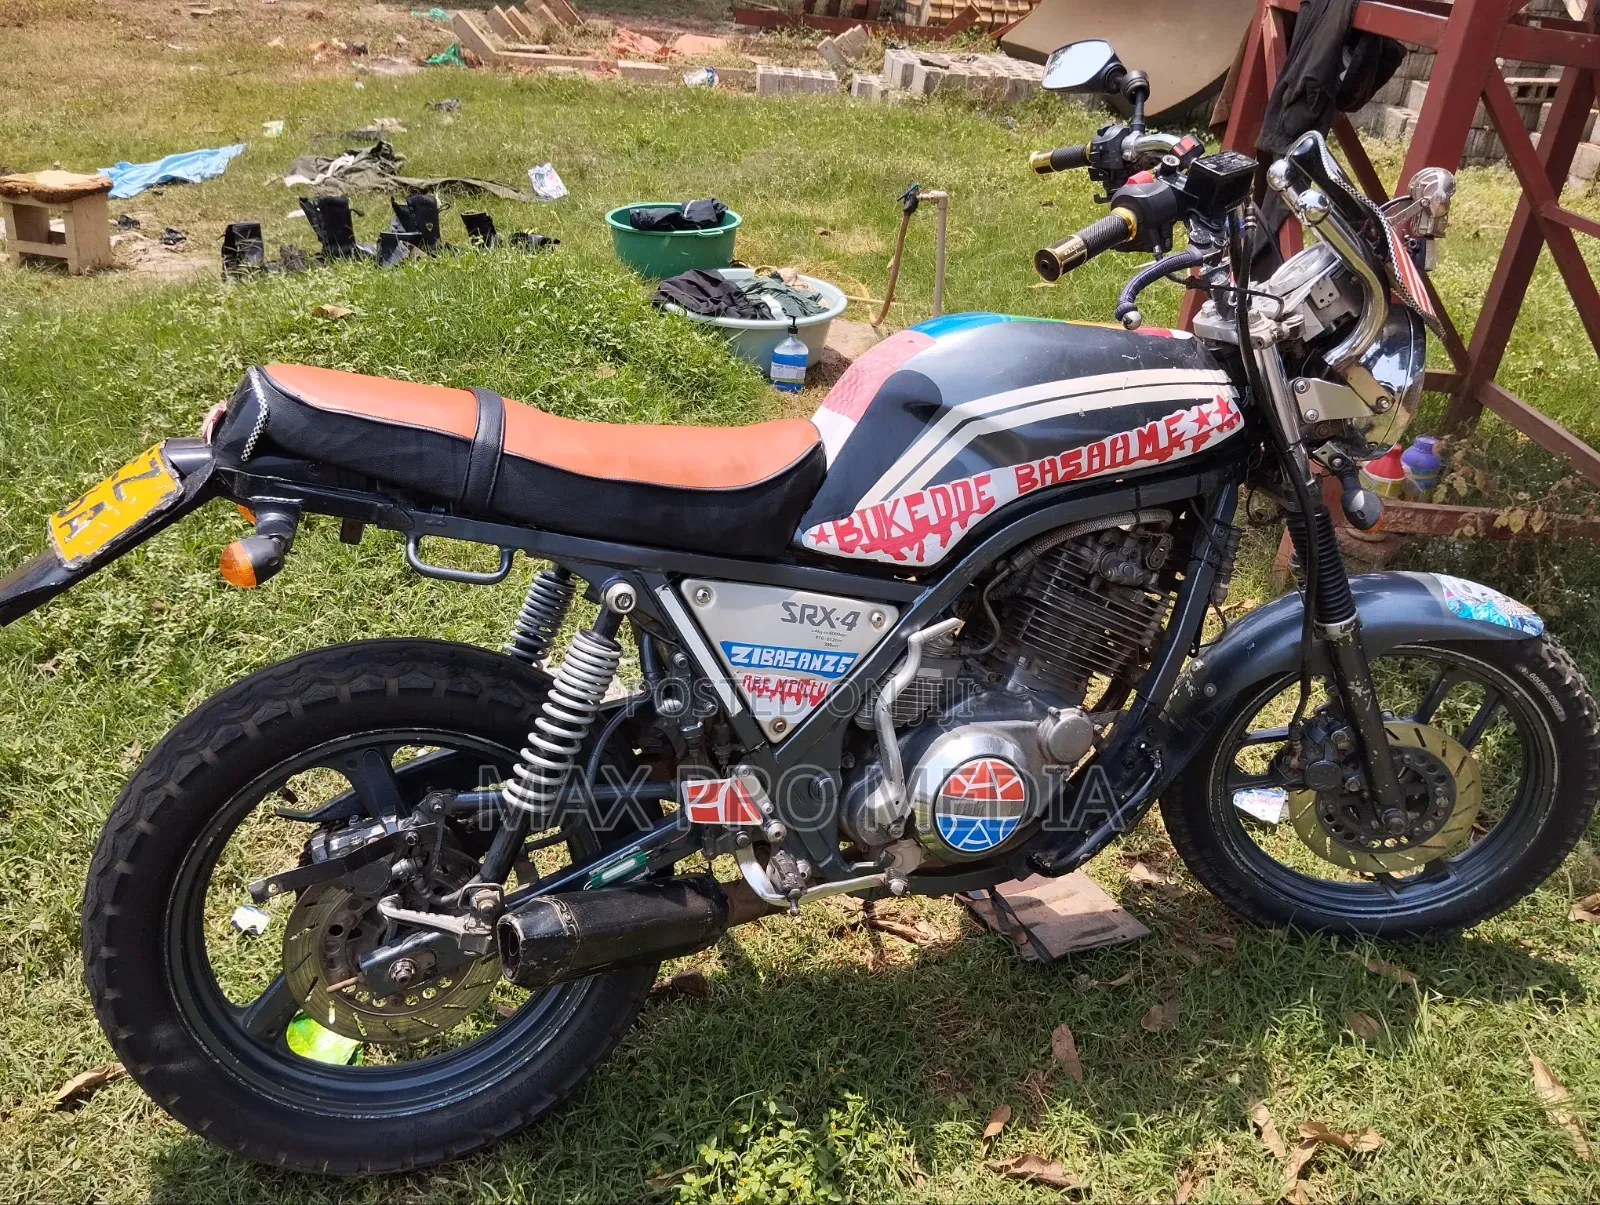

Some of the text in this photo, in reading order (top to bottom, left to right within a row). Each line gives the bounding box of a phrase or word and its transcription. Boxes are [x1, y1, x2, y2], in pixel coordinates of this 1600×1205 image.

[833, 474, 996, 553] BUKEDDE
[730, 644, 856, 675] ZIBASANZE
[1529, 672, 1551, 694] GOLDEN
